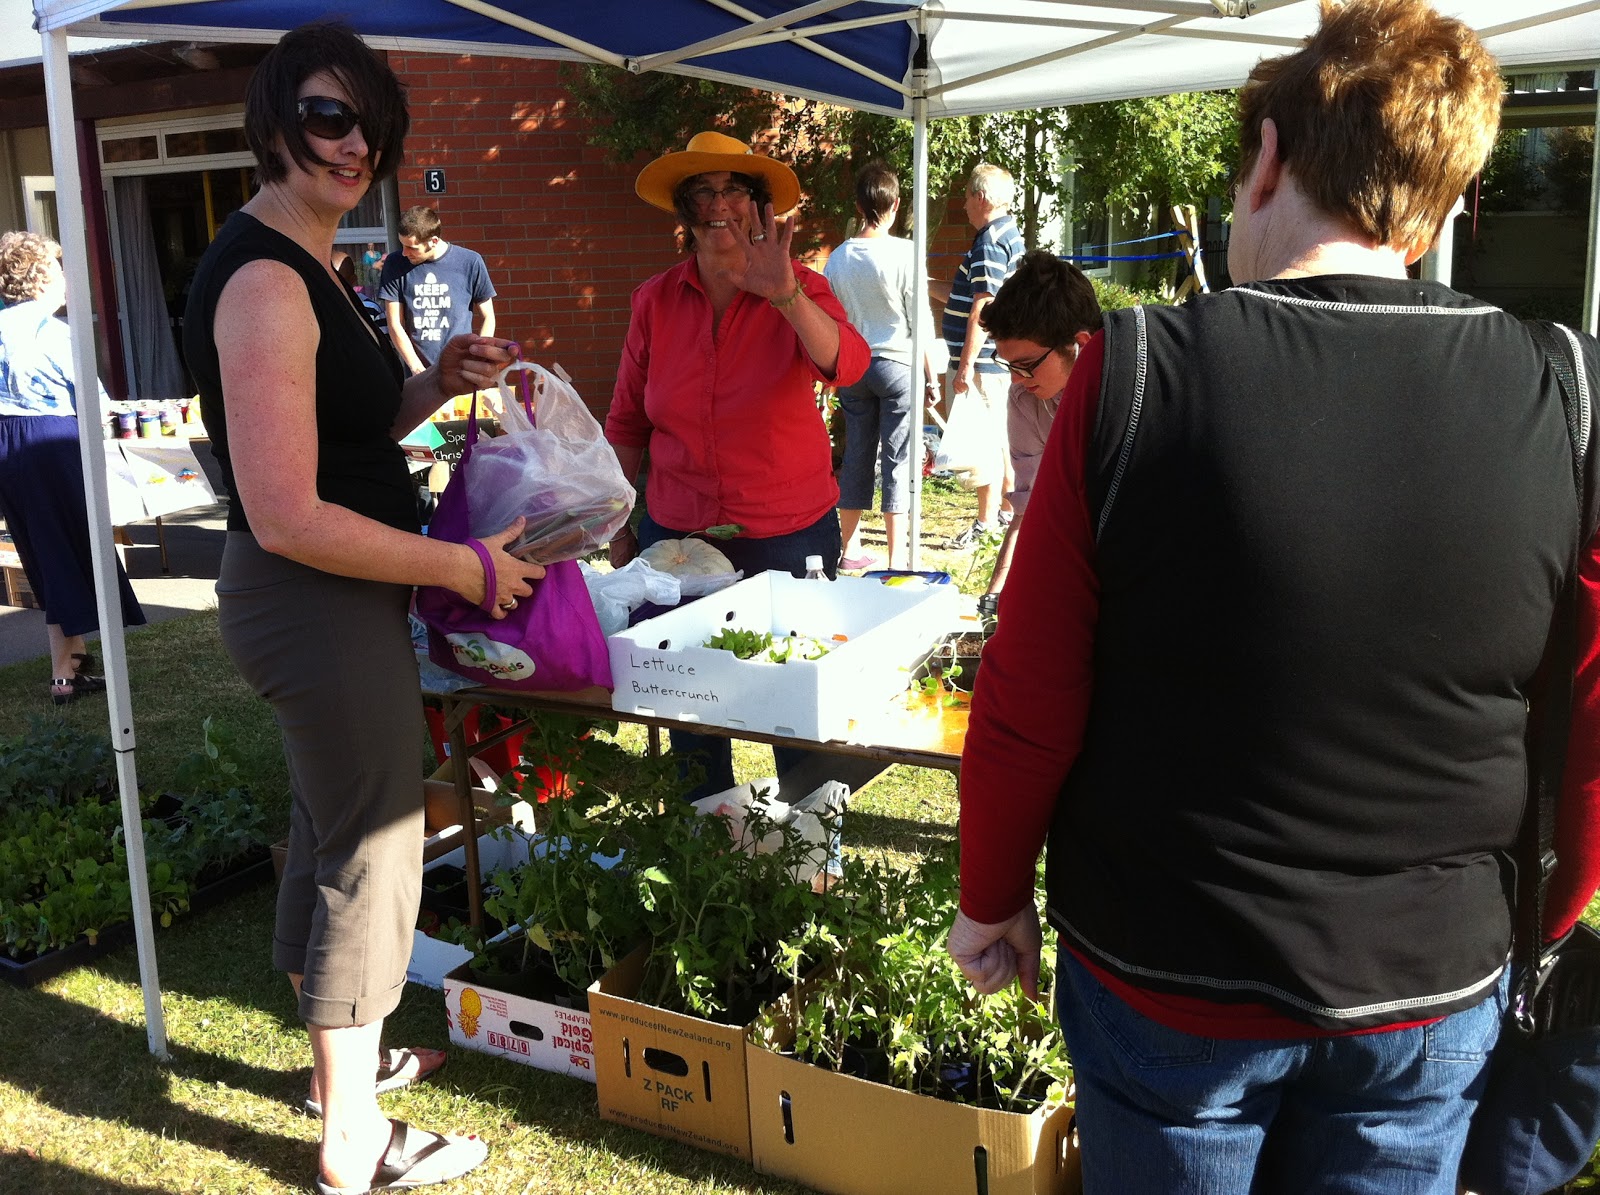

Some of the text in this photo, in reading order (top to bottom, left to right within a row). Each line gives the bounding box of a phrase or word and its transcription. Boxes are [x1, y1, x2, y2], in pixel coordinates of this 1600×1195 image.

[430, 171, 440, 191] 5
[414, 283, 449, 296] KEEP
[413, 296, 451, 309] CALM
[424, 309, 440, 317] AND
[413, 316, 450, 330] EAT A
[421, 328, 442, 341] PIE
[630, 653, 696, 675] Lettuce
[632, 681, 719, 702] Buttercrunch
[555, 1010, 591, 1025] NEAPPLES
[560, 1022, 593, 1043] Gold
[599, 1007, 731, 1050] www.produceofNewZealand.org
[570, 1055, 590, 1069] Dole
[643, 1078, 695, 1103] Z PACK
[661, 1097, 679, 1112] RF
[608, 1108, 739, 1153] www.produceofNewZealand.org
